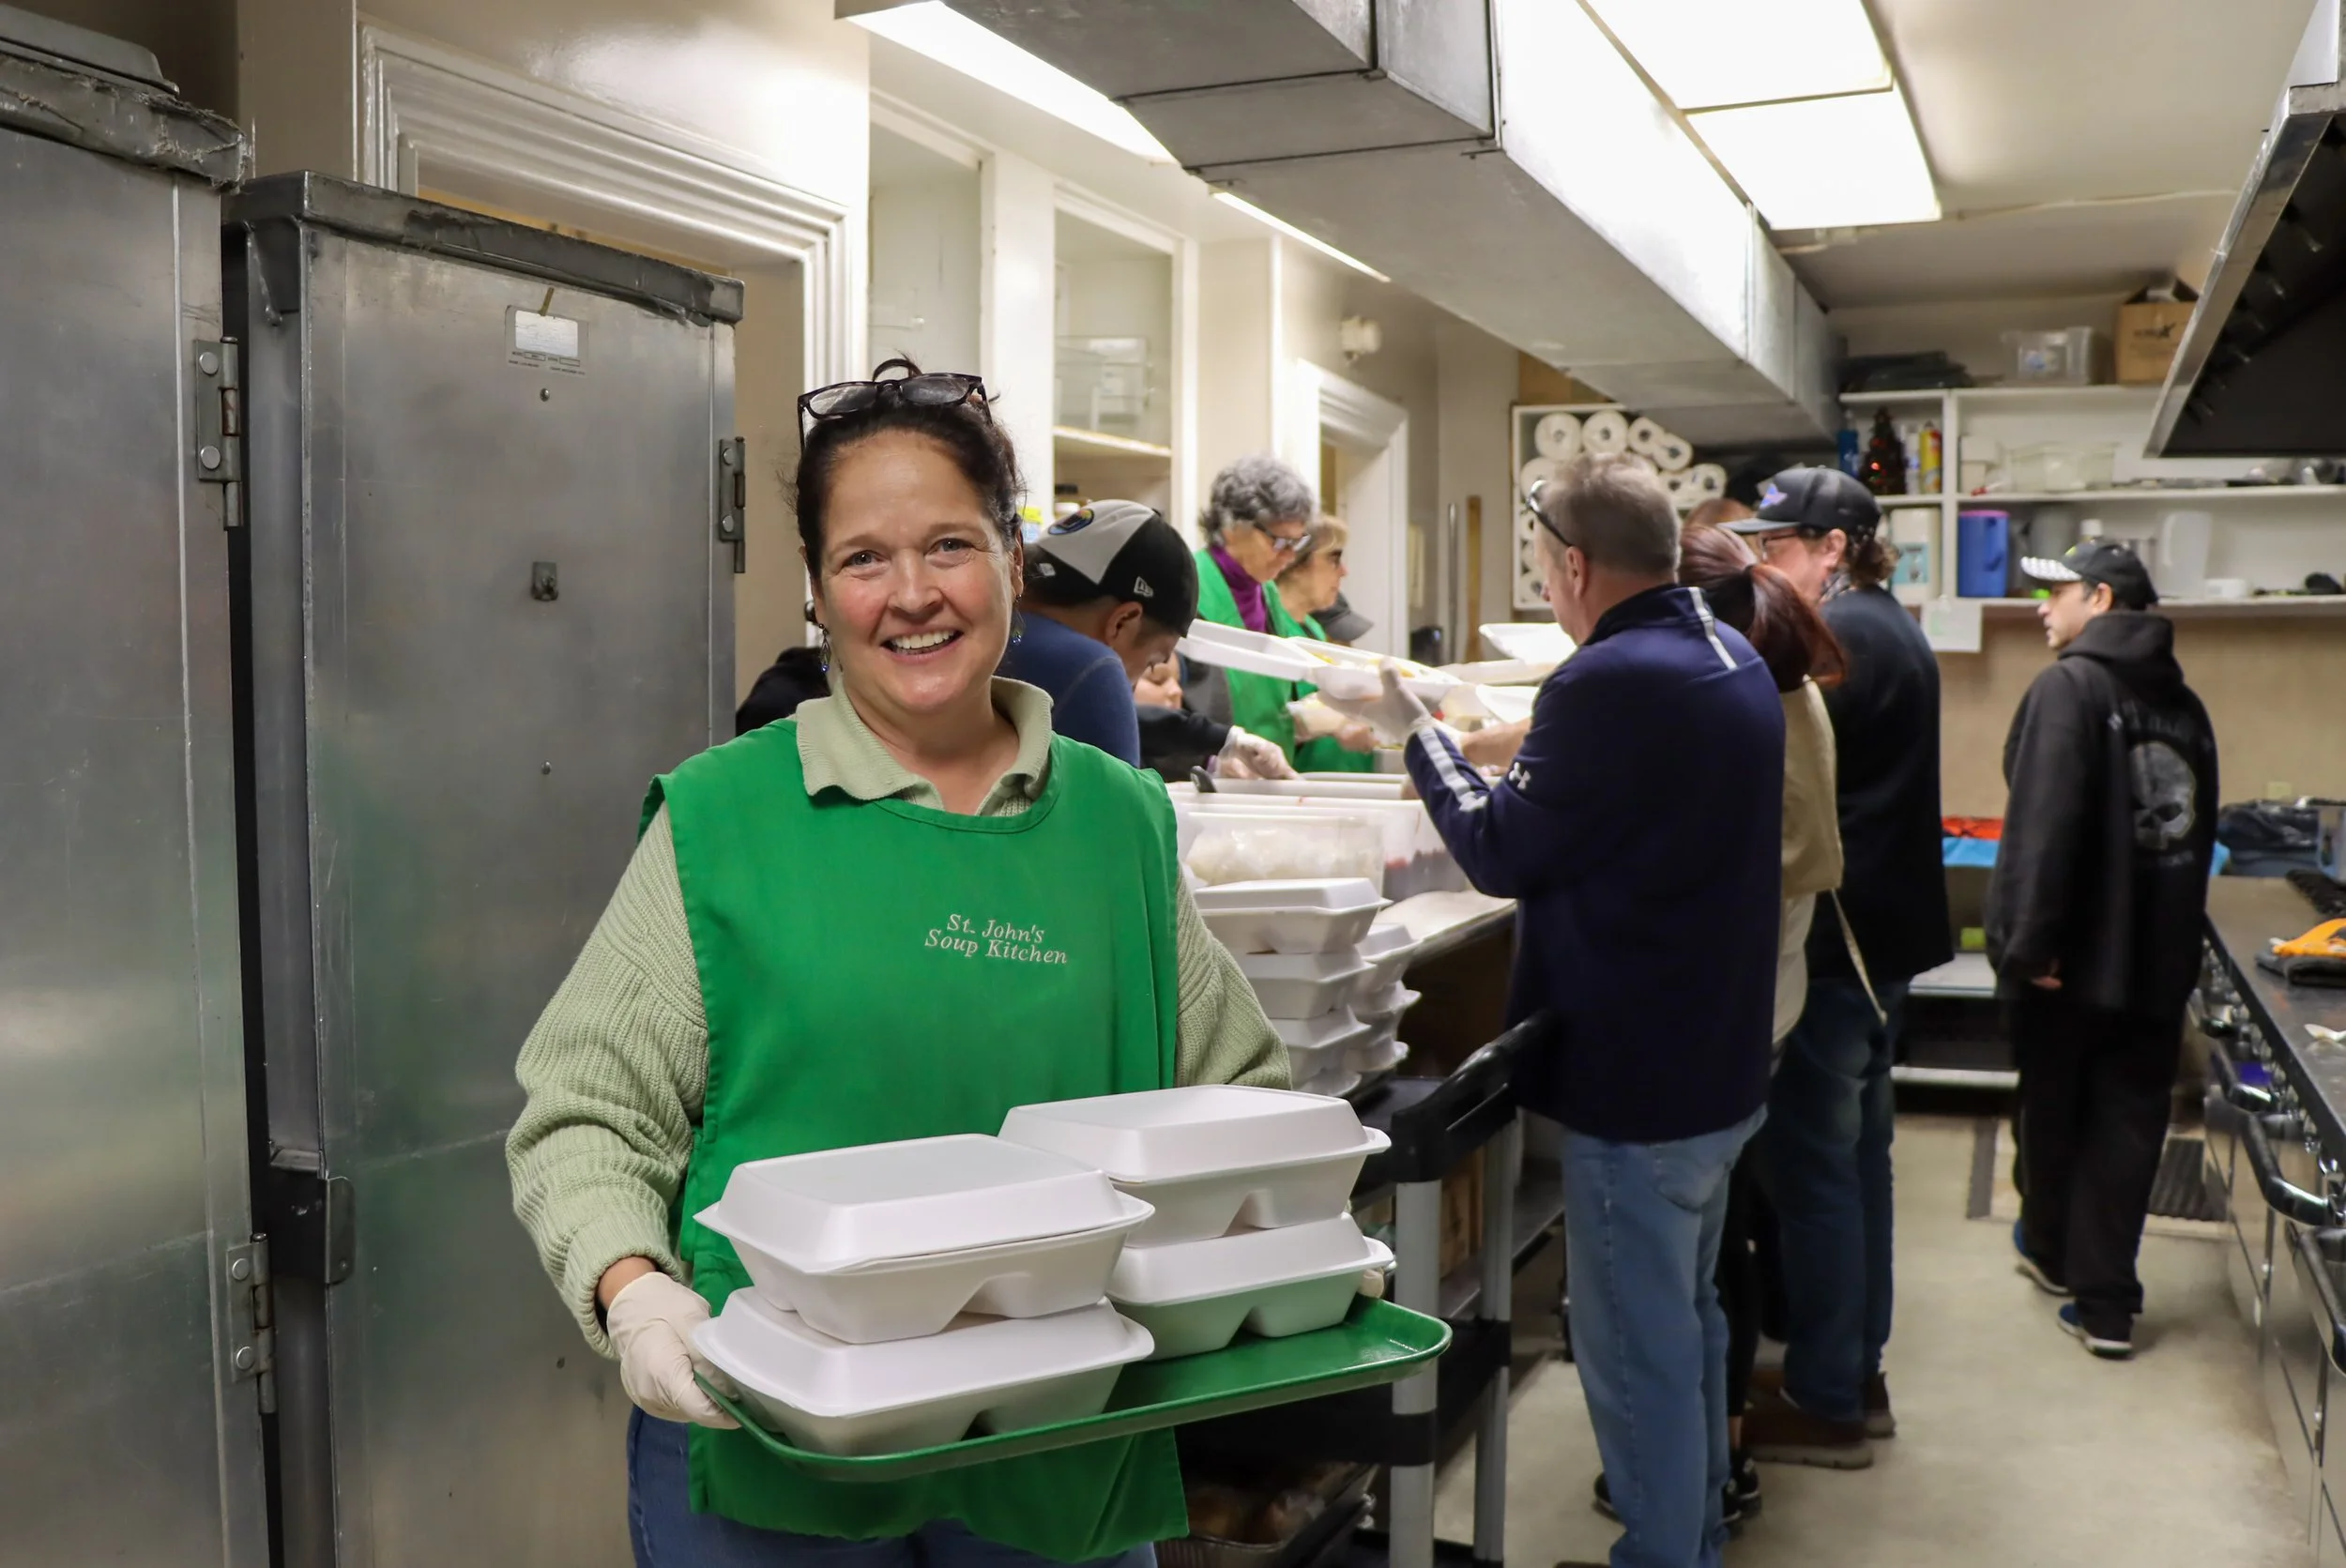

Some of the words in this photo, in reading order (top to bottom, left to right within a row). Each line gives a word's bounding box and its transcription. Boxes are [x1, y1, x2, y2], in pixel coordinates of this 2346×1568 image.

[947, 913, 976, 934] St.
[982, 919, 1044, 944] John's
[924, 928, 979, 958] Soup
[984, 939, 1068, 964] Kitchen
